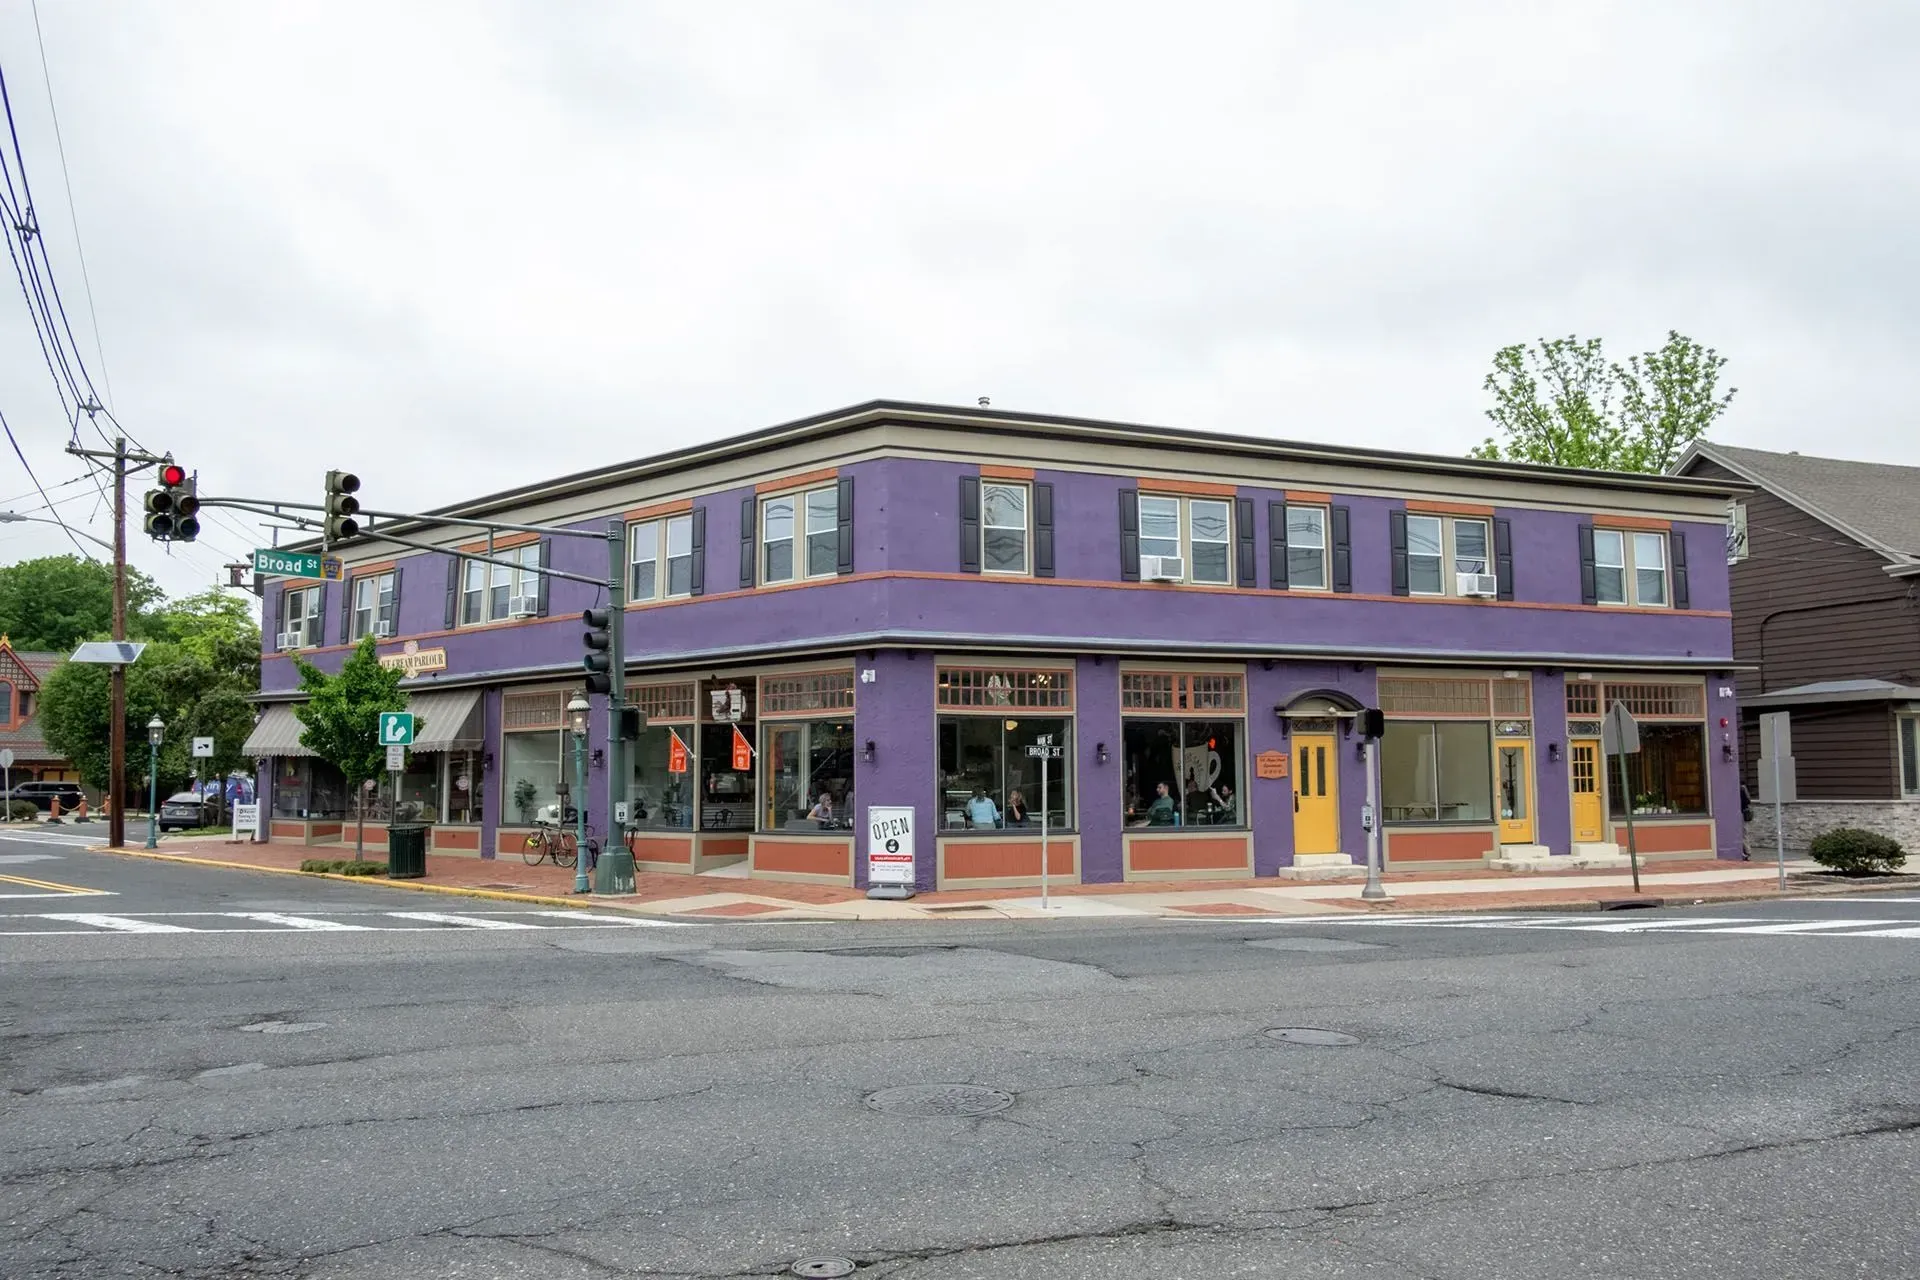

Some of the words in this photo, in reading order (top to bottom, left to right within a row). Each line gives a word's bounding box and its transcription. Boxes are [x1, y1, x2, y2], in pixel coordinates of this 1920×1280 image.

[258, 554, 302, 573] Broad
[306, 558, 318, 569] St
[414, 653, 444, 667] PARLOUR
[1029, 747, 1050, 757] BROAD
[1052, 747, 1061, 757] ST
[872, 816, 910, 841] OPEN
